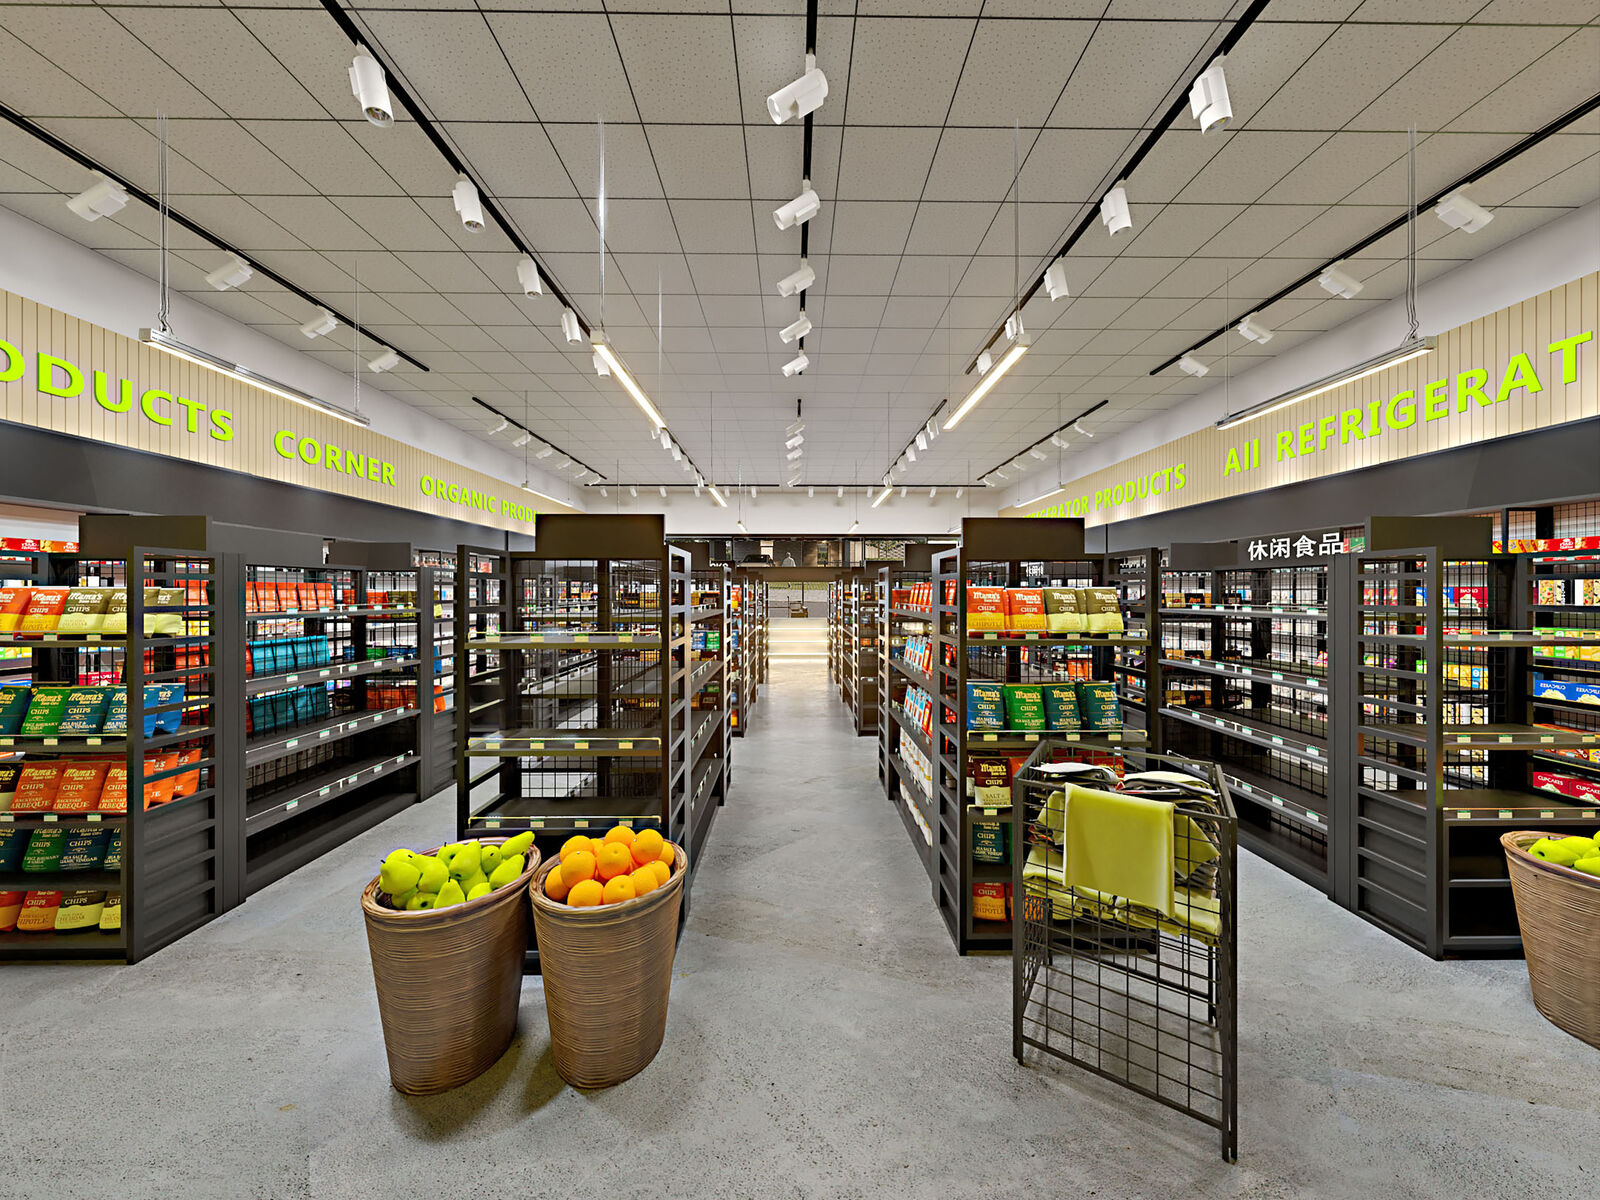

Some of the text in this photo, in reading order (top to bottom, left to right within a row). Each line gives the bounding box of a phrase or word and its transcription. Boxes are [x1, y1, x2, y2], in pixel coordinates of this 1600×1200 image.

[1224, 330, 1593, 476] All REFRIGERAT
[274, 430, 396, 487] CORNER
[421, 475, 496, 513] ORGANIC
[501, 499, 545, 524] PROD
[1095, 463, 1187, 511] PRODUCTS
[1248, 532, 1345, 561] 休闲食品
[64, 897, 88, 905] CHIPS
